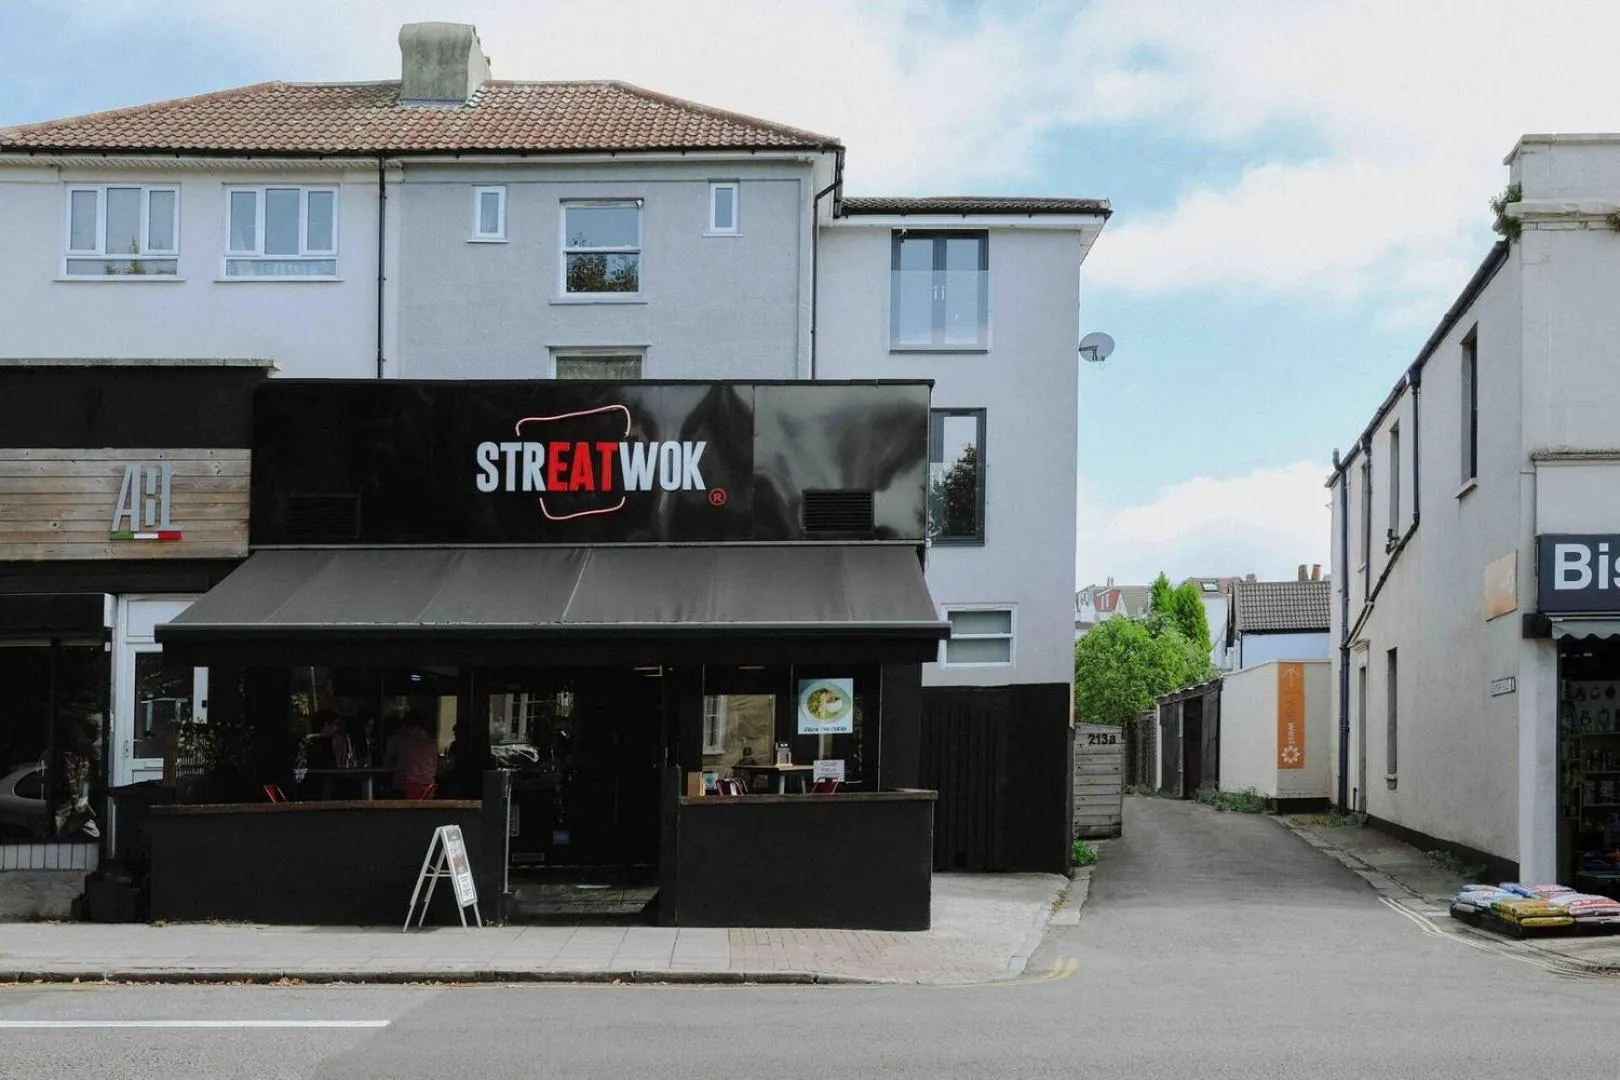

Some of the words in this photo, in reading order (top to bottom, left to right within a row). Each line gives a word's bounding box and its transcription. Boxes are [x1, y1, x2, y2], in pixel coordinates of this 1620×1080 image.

[476, 441, 707, 492] STREATWOK
[1554, 543, 1620, 590] Bi
[1088, 733, 1116, 745] 213a
